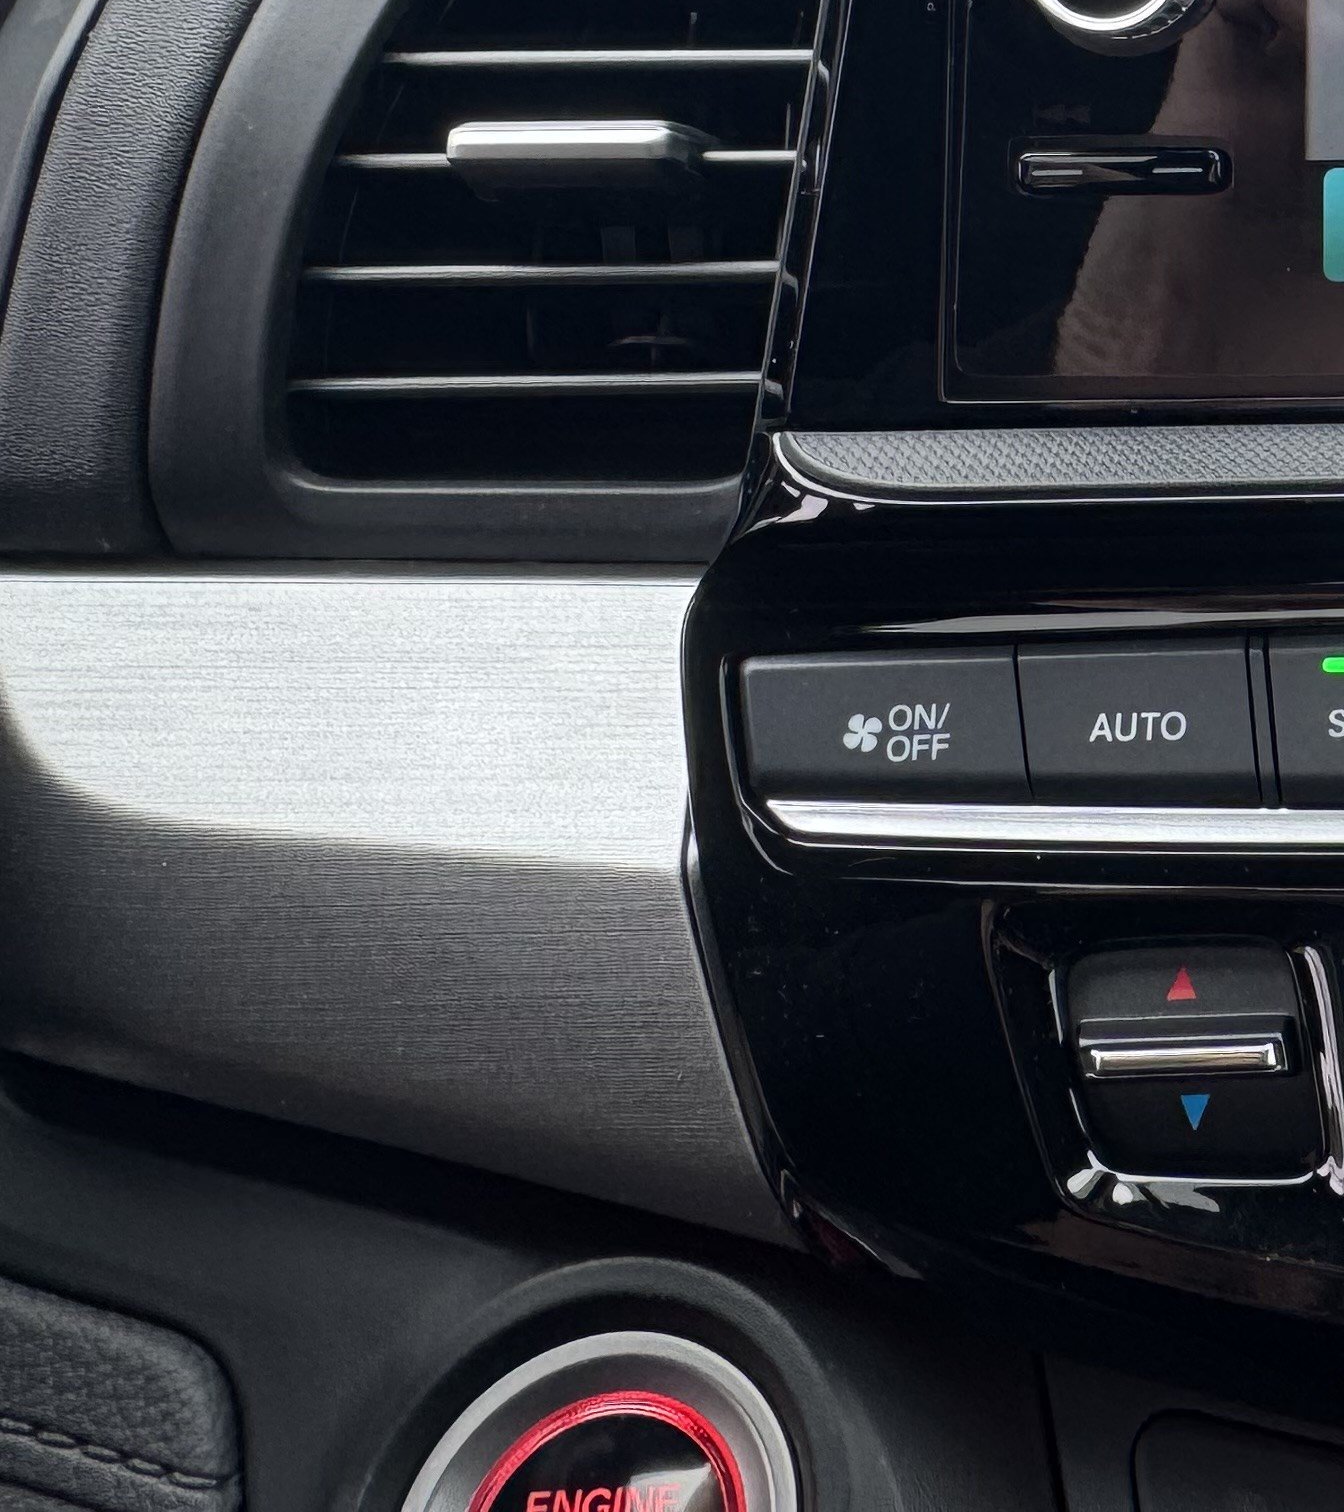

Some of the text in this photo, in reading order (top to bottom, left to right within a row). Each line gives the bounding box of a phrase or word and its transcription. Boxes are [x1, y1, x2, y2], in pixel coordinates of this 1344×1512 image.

[888, 702, 951, 732] ON/
[1088, 711, 1187, 744] AUTO
[886, 732, 951, 764] OFF
[526, 1483, 681, 1512] ENGINE
